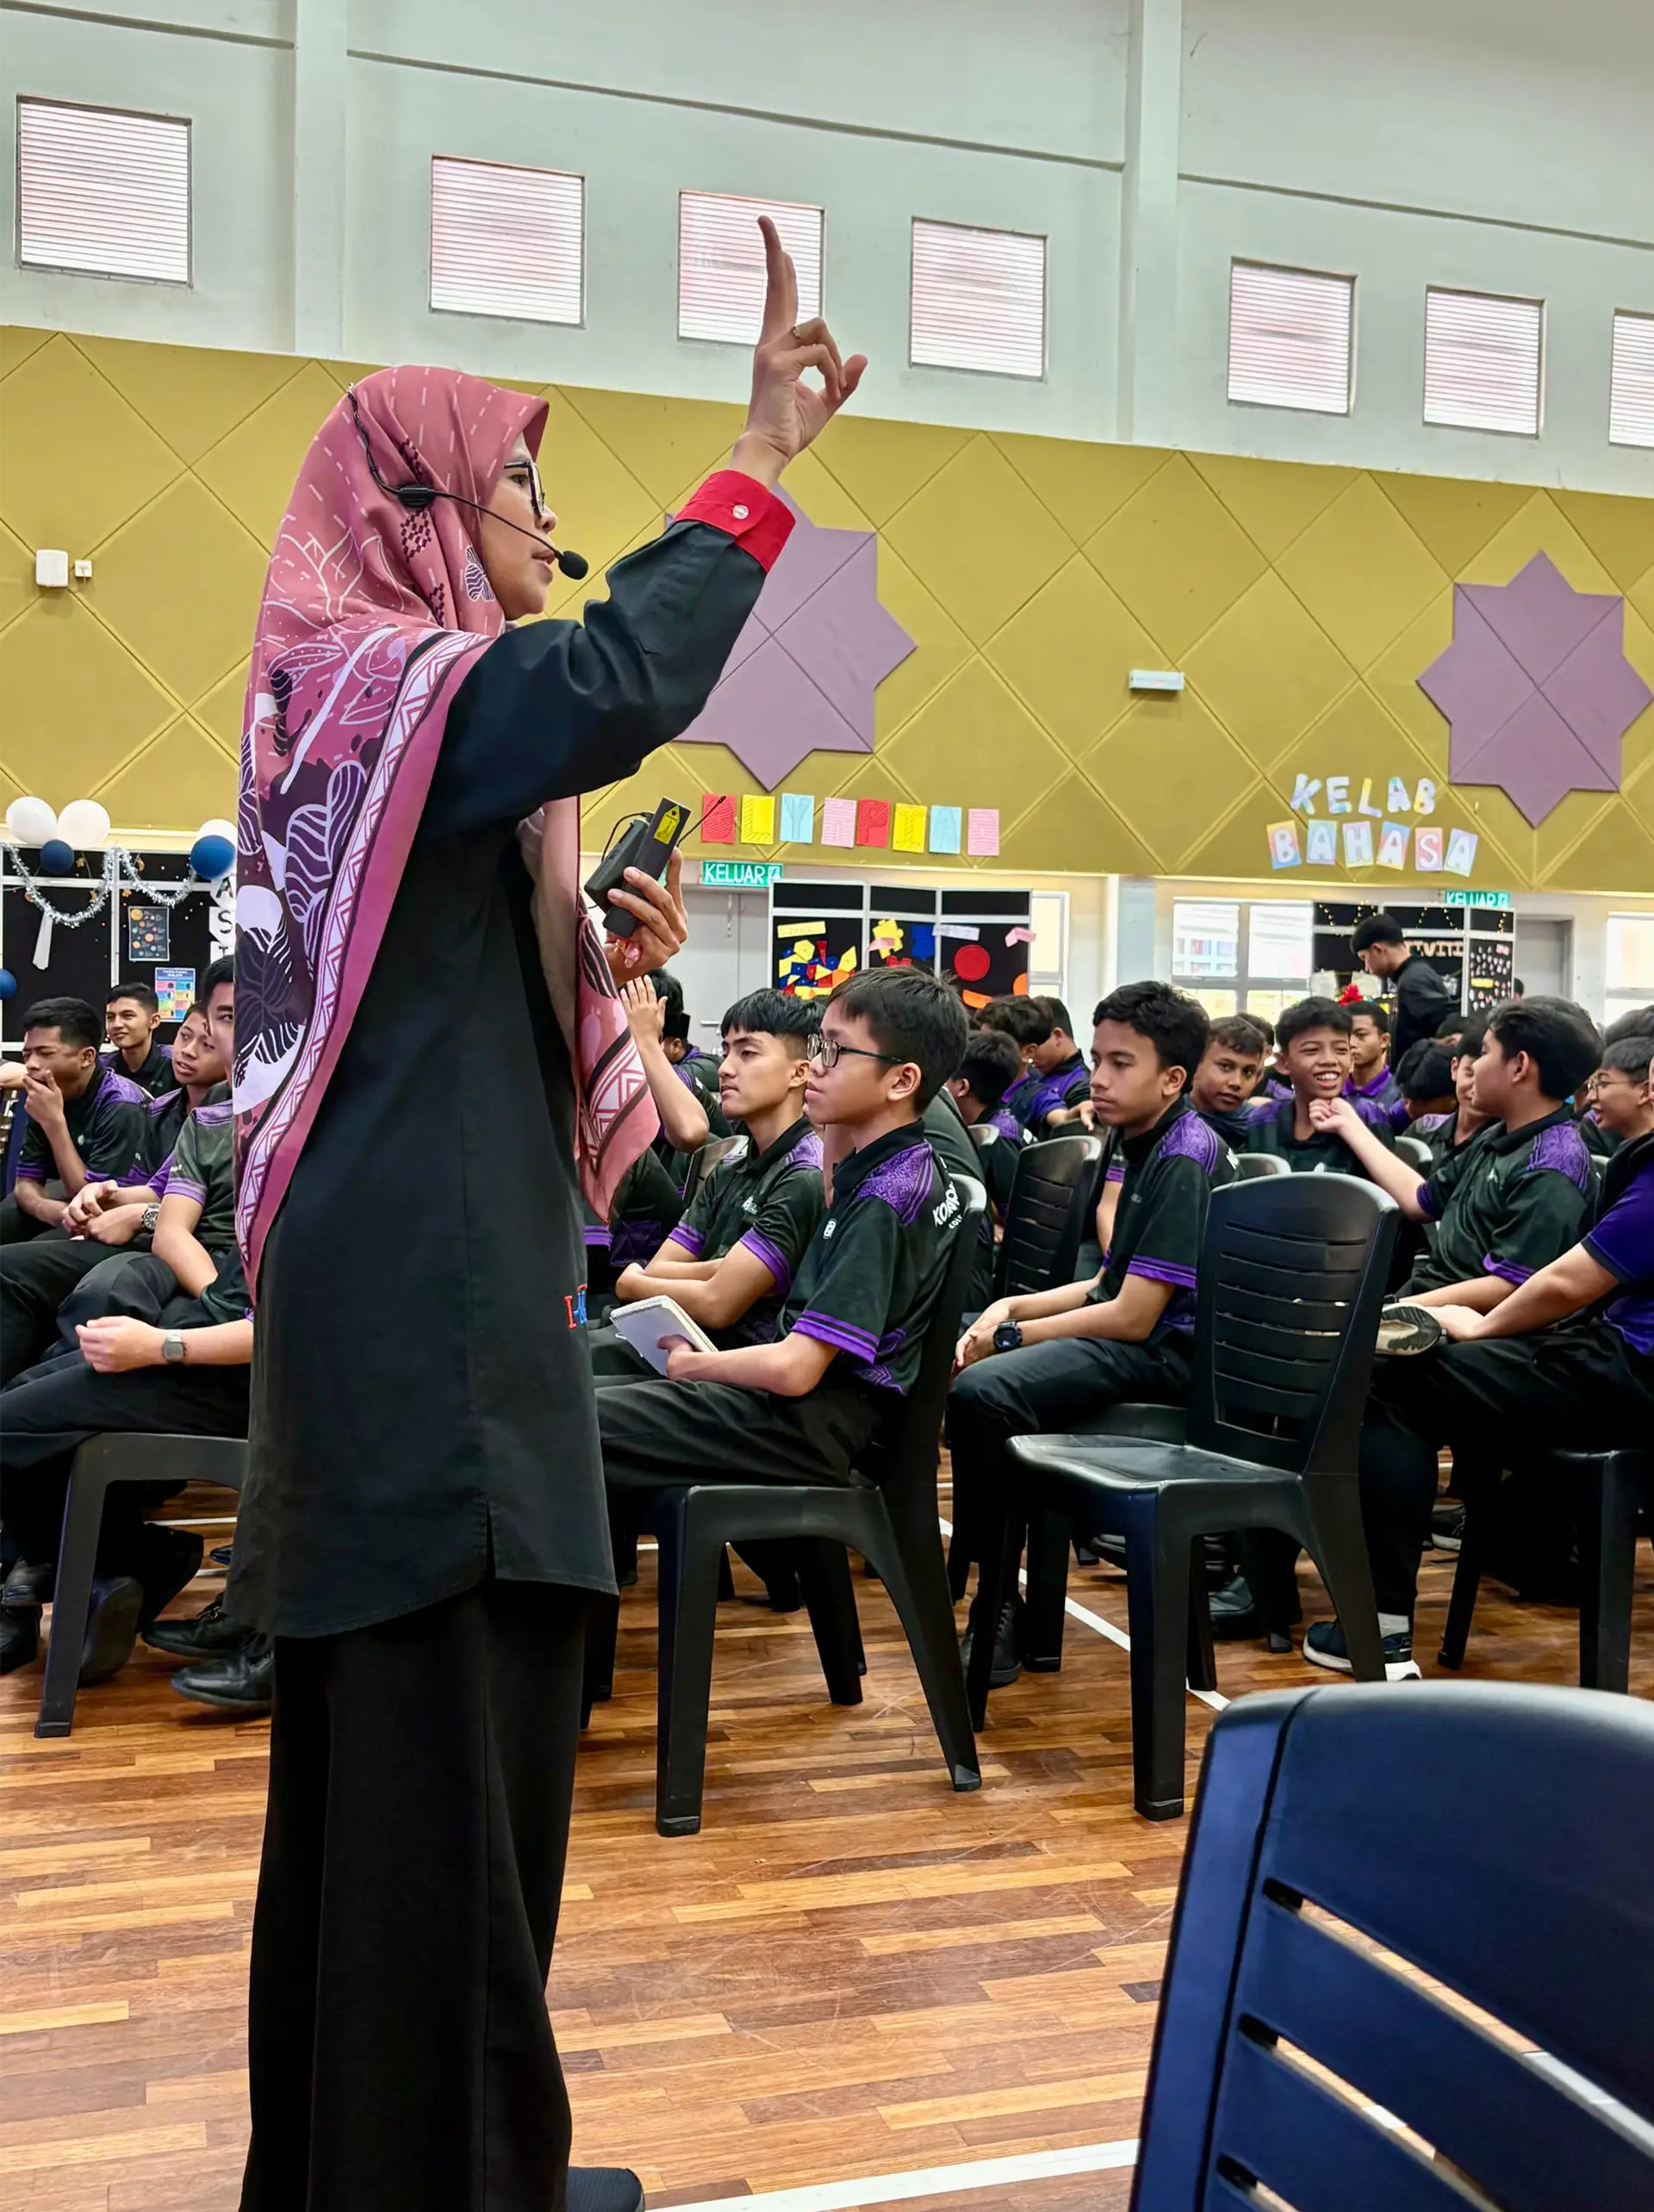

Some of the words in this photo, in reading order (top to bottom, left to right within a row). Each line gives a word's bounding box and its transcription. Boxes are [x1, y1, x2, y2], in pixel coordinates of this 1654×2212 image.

[1290, 774, 1436, 817] KELAB
[1273, 824, 1471, 872] BAHASA
[705, 863, 766, 885] KELUAR
